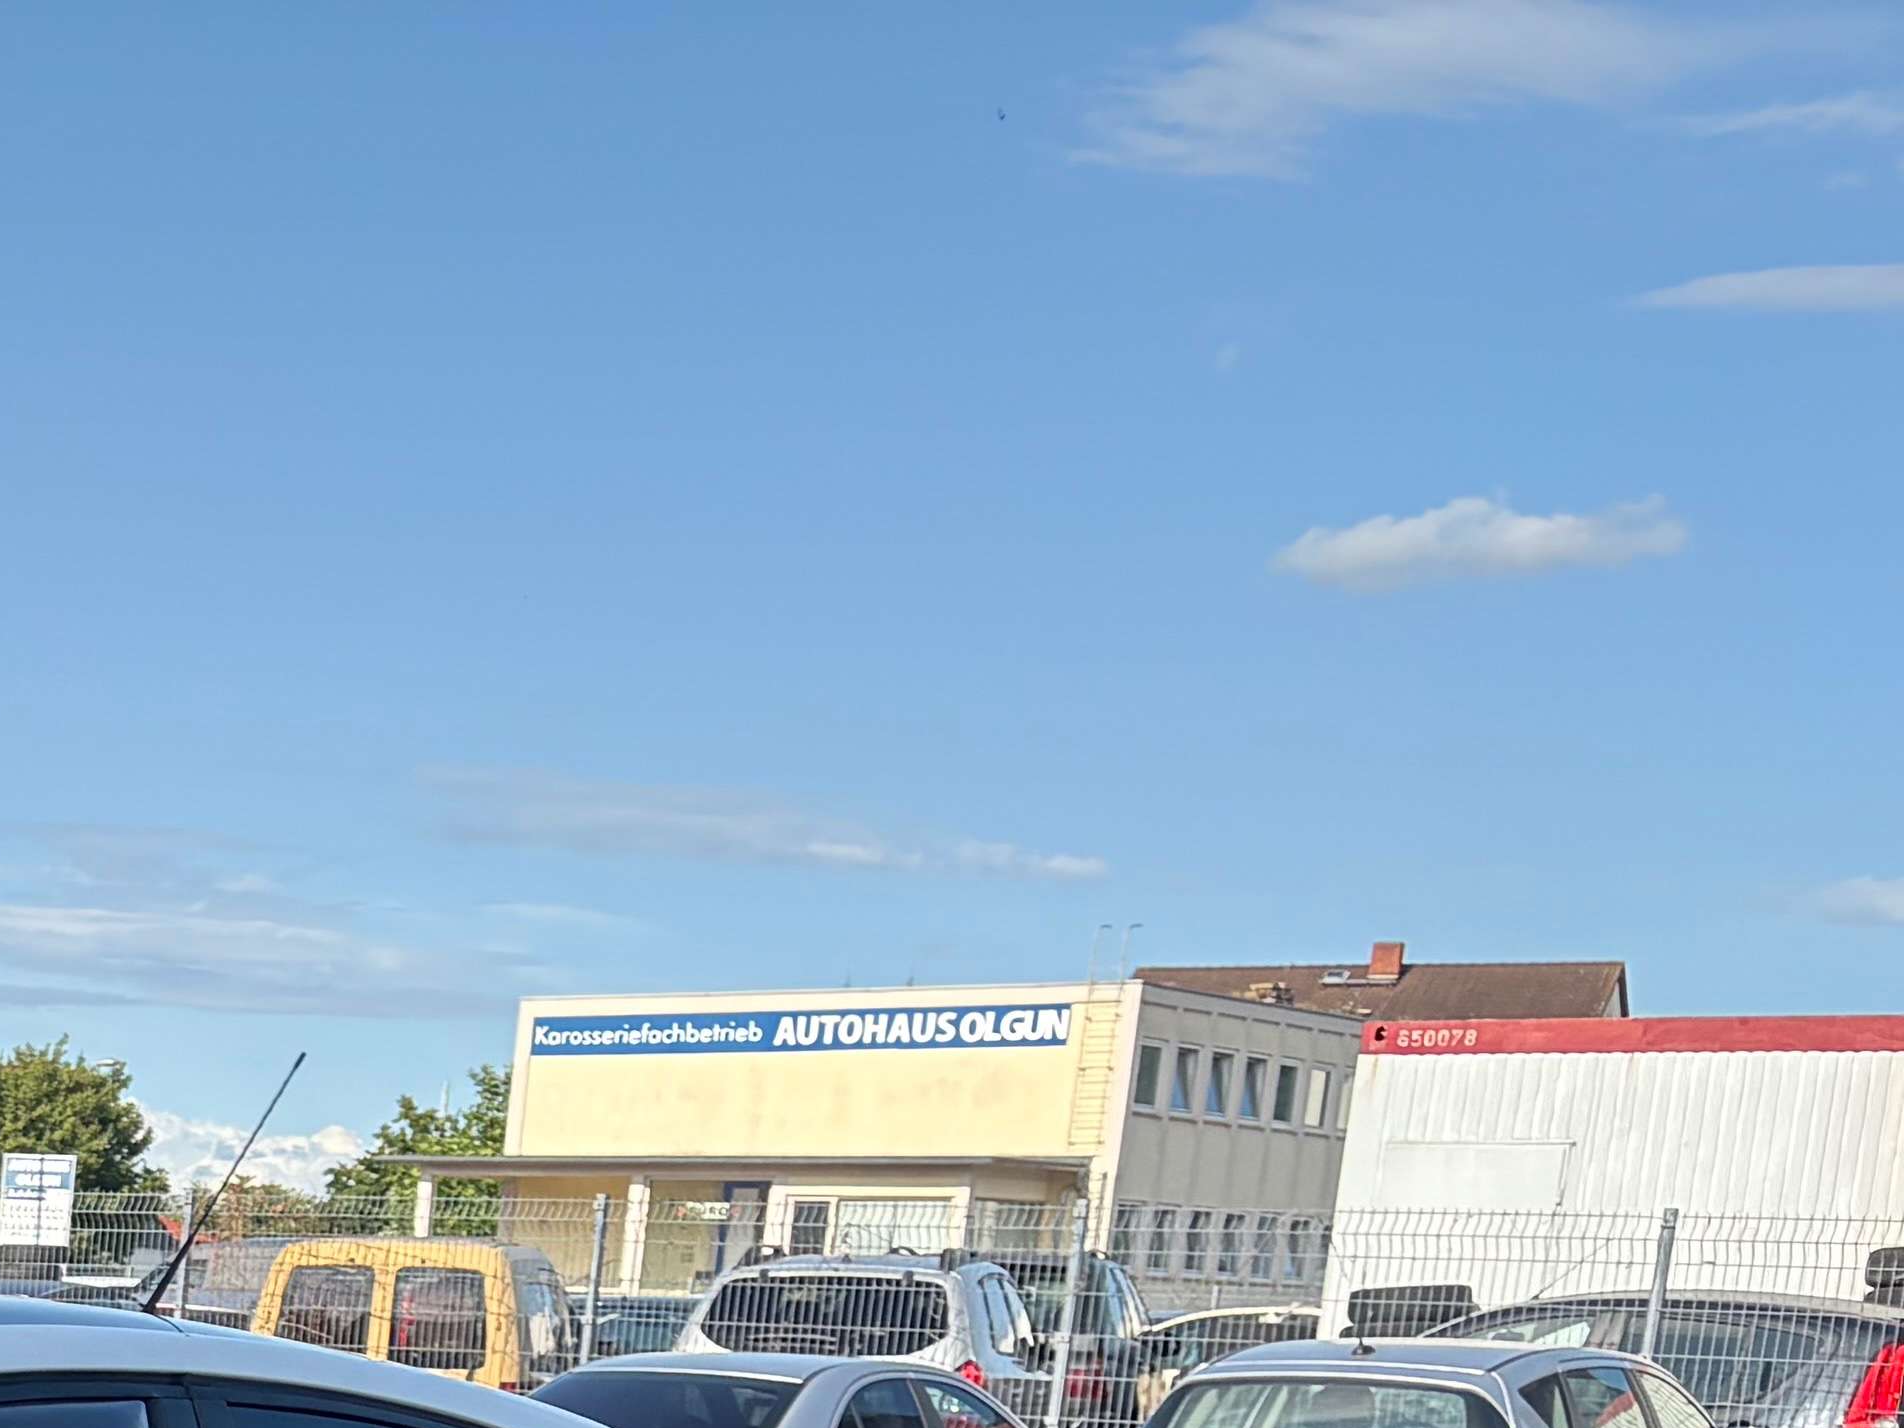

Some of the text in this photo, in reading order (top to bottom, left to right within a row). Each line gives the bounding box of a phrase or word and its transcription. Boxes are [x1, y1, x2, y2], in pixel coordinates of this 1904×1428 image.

[534, 1008, 1071, 1046] Karosseriefachbetrieb AUTOHAUS OLGUN
